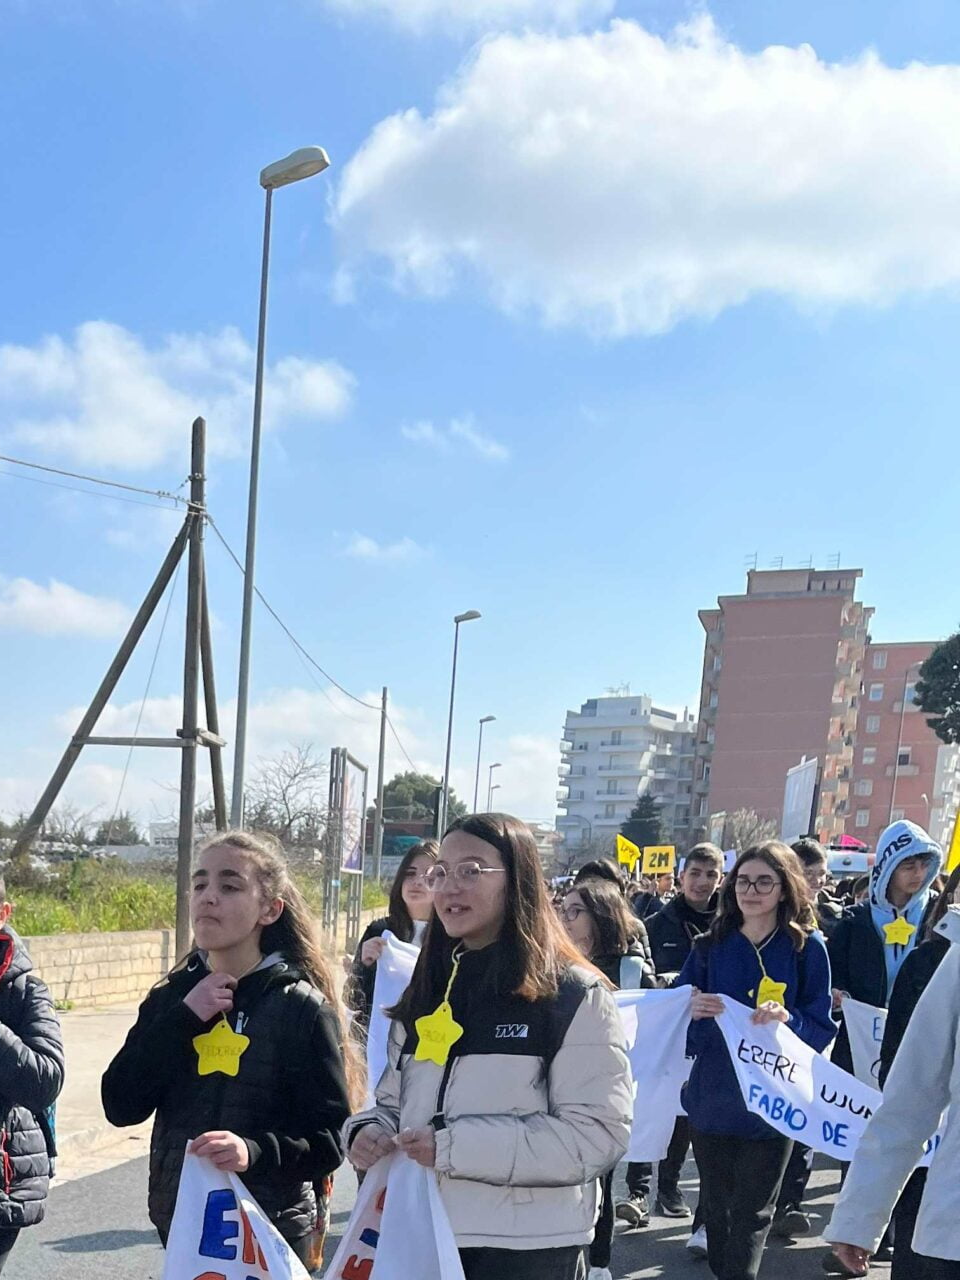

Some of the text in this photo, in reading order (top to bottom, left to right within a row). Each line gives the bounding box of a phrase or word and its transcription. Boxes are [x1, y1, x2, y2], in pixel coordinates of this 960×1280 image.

[648, 852, 670, 868] 2M
[748, 1083, 850, 1148] FABIO DE
